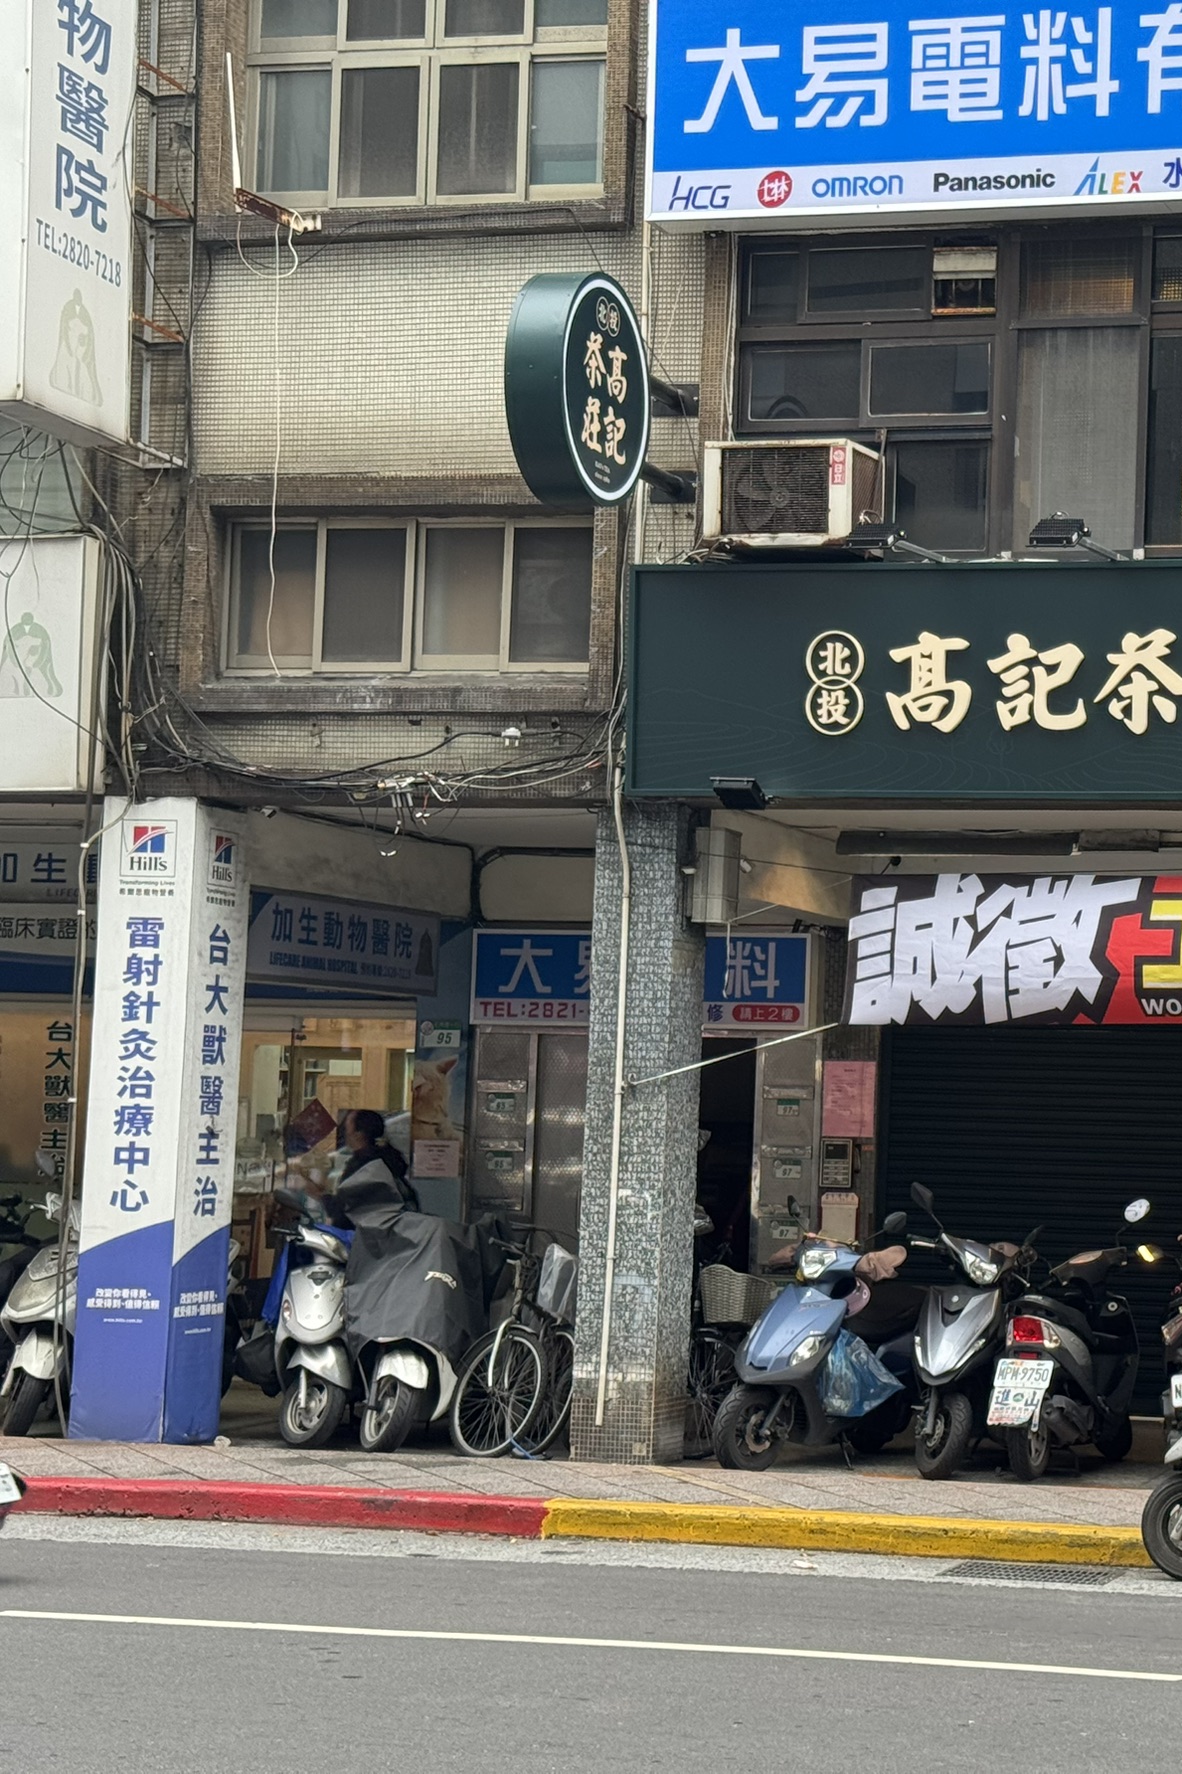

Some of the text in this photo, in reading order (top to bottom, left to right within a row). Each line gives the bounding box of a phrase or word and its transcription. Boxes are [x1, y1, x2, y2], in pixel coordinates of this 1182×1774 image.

[55, 0, 112, 233] 物醫院
[668, 175, 731, 210] HCG
[811, 175, 904, 198] OMRON
[932, 167, 1056, 193] Panasonic
[1073, 156, 1144, 196] ALEX
[35, 218, 122, 288] TEL:2820-7218
[816, 641, 852, 726] 北投
[129, 856, 168, 872] Hill's
[212, 865, 233, 882] Hill's
[270, 901, 414, 959] 加生動物醫院
[436, 1032, 453, 1044] 95
[479, 1001, 591, 1018] TEL:2821-
[109, 917, 165, 1212] 雷射針灸治療中心
[193, 923, 231, 1217] 台大獸醫主治
